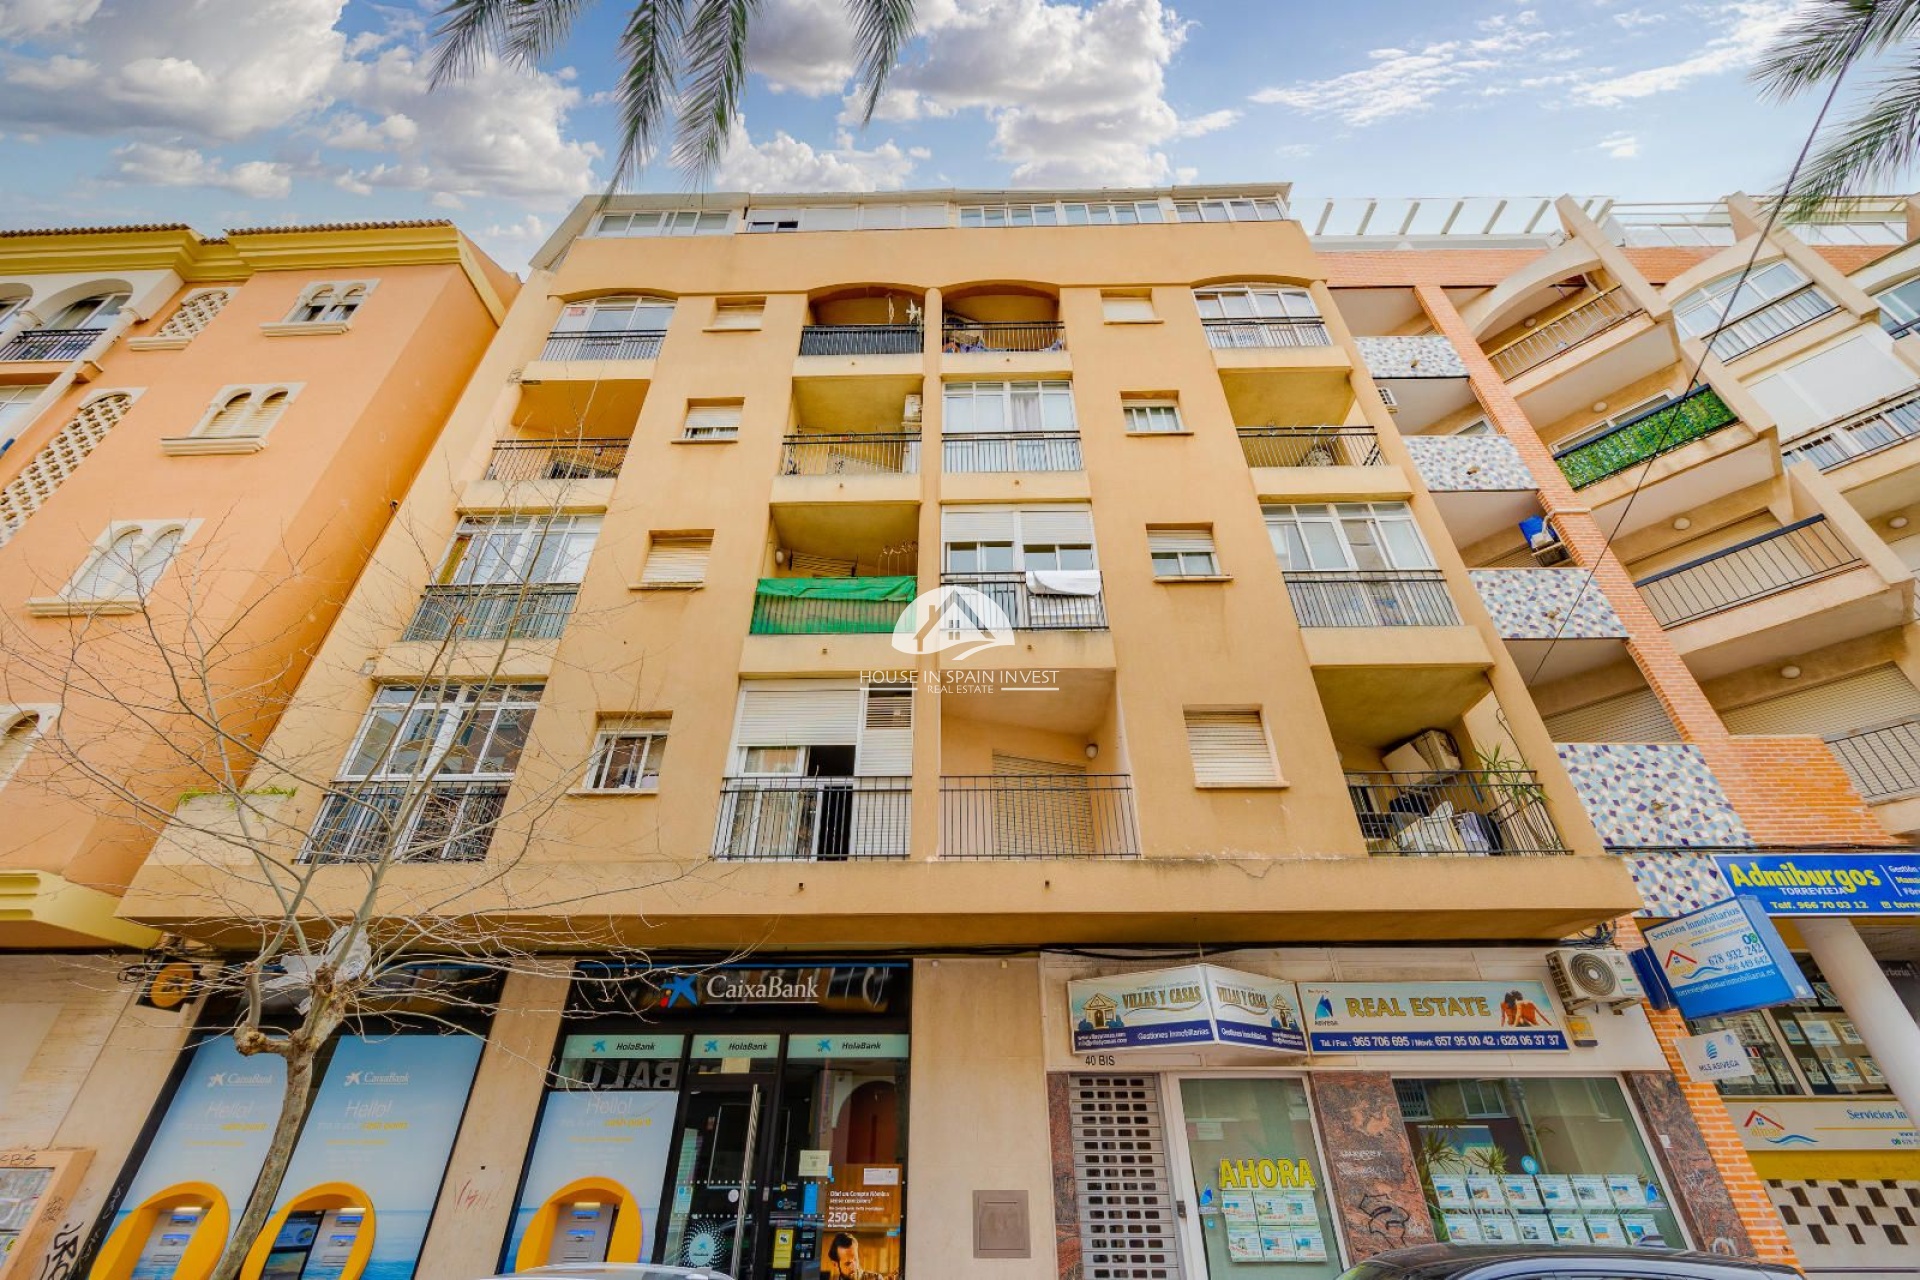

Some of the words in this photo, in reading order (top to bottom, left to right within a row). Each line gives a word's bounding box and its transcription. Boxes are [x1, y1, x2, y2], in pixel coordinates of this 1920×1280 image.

[1729, 862, 1882, 893] Admiburgos
[1779, 887, 1846, 896] TORREVIEJA
[1770, 901, 1796, 909] Telf.
[1797, 901, 1818, 909] 966
[1819, 901, 1834, 909] 70
[1836, 901, 1852, 909] 03
[1855, 901, 1869, 909] 12
[1651, 924, 1685, 941] Servicios
[1686, 907, 1741, 930] Inmobiliarios
[1708, 955, 1724, 966] 678
[1726, 948, 1742, 961] 932
[1747, 943, 1763, 955] 242
[706, 974, 820, 998] CaixaBank
[1122, 991, 1158, 1010] VILLAS
[1158, 989, 1166, 1007] Y
[1169, 986, 1201, 1004] CASAS
[1217, 986, 1242, 1004] VILLAS
[1241, 990, 1248, 1006] Y
[1247, 991, 1268, 1009] CASAS
[1345, 997, 1407, 1018] REAL
[1409, 996, 1492, 1018] ESTATE
[1138, 1030, 1169, 1041] Gestiones
[1169, 1028, 1209, 1039] Inmobiliarias
[1352, 1036, 1371, 1047] 965
[1371, 1036, 1389, 1047] 706
[1391, 1036, 1410, 1047] 695
[1434, 1035, 1452, 1046] 657
[1453, 1035, 1467, 1046] 95
[1468, 1035, 1481, 1046] 00
[1482, 1035, 1495, 1046] 42
[1500, 1035, 1519, 1046] 628
[1519, 1035, 1532, 1046] 06
[1533, 1034, 1545, 1046] 37
[1547, 1034, 1560, 1046] 37
[616, 1042, 656, 1051] HolaBank
[728, 1042, 768, 1051] HolaBank
[842, 1041, 881, 1050] HolaBank
[1085, 1055, 1097, 1066] 40
[1099, 1055, 1115, 1066] BIS
[1699, 1063, 1713, 1071] MLS
[1713, 1060, 1740, 1070] ASIVEGA
[345, 1100, 393, 1118] Hello!
[1846, 1109, 1892, 1120] Servicios
[1219, 1158, 1316, 1189] AHORA
[828, 1212, 848, 1223] 250
[850, 1212, 857, 1222] €
